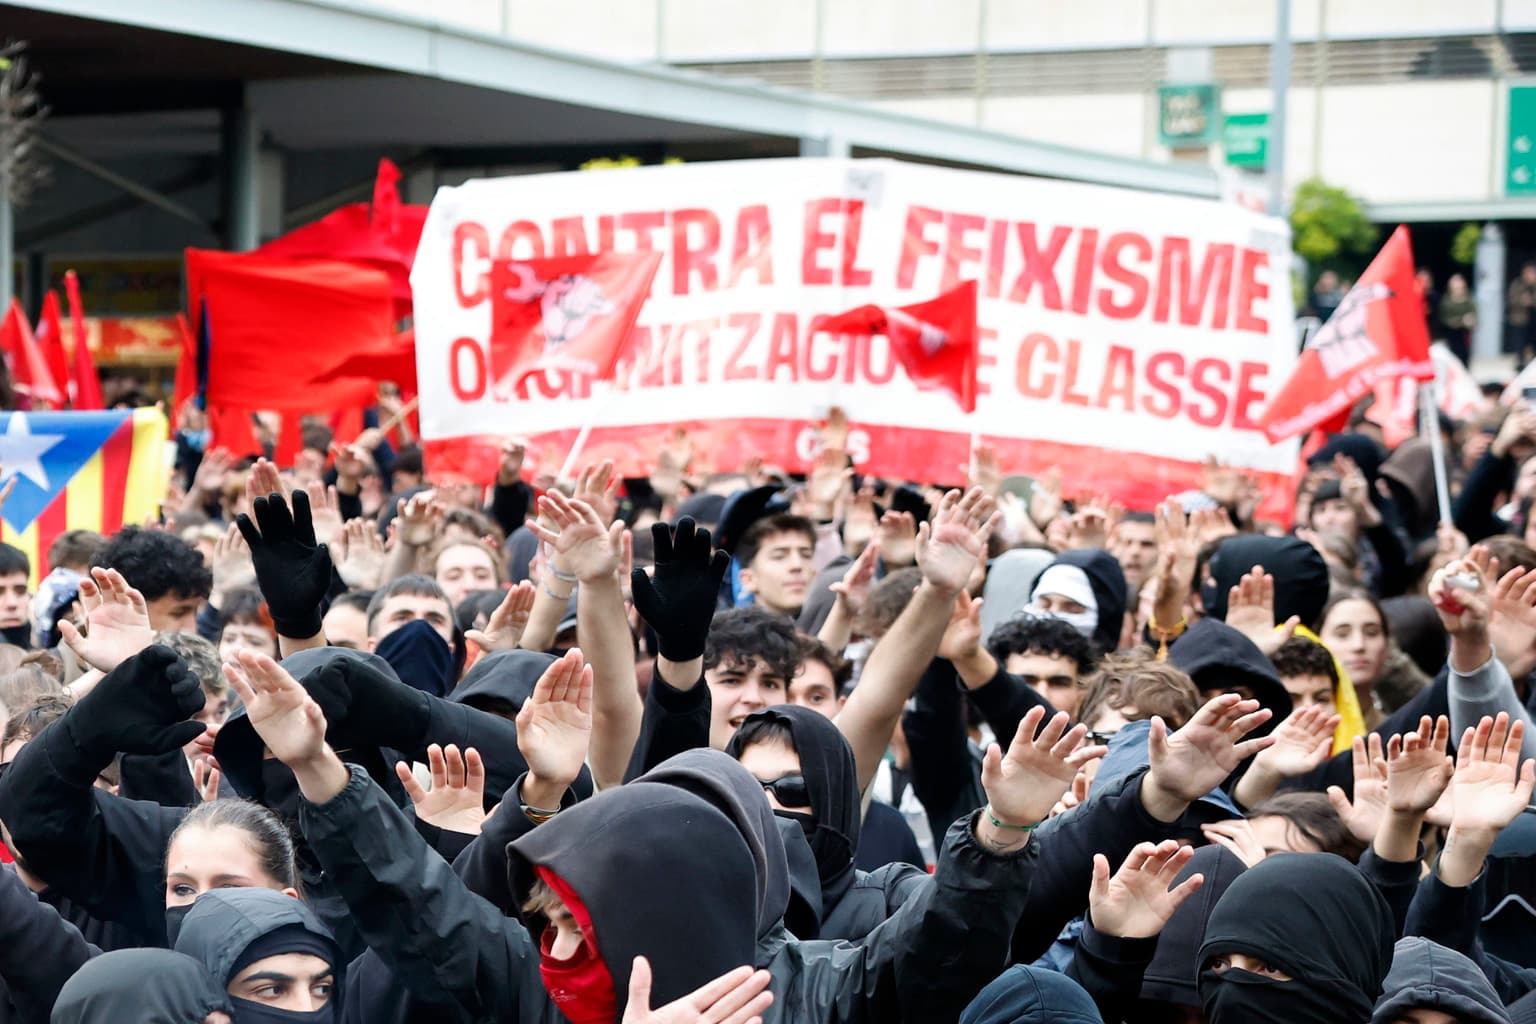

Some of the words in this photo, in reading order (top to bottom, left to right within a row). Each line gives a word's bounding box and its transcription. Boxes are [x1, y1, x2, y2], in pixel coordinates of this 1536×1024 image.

[800, 197, 873, 287] EL
[895, 205, 1270, 334] FEIXISME
[1014, 332, 1270, 433] CLASSE
